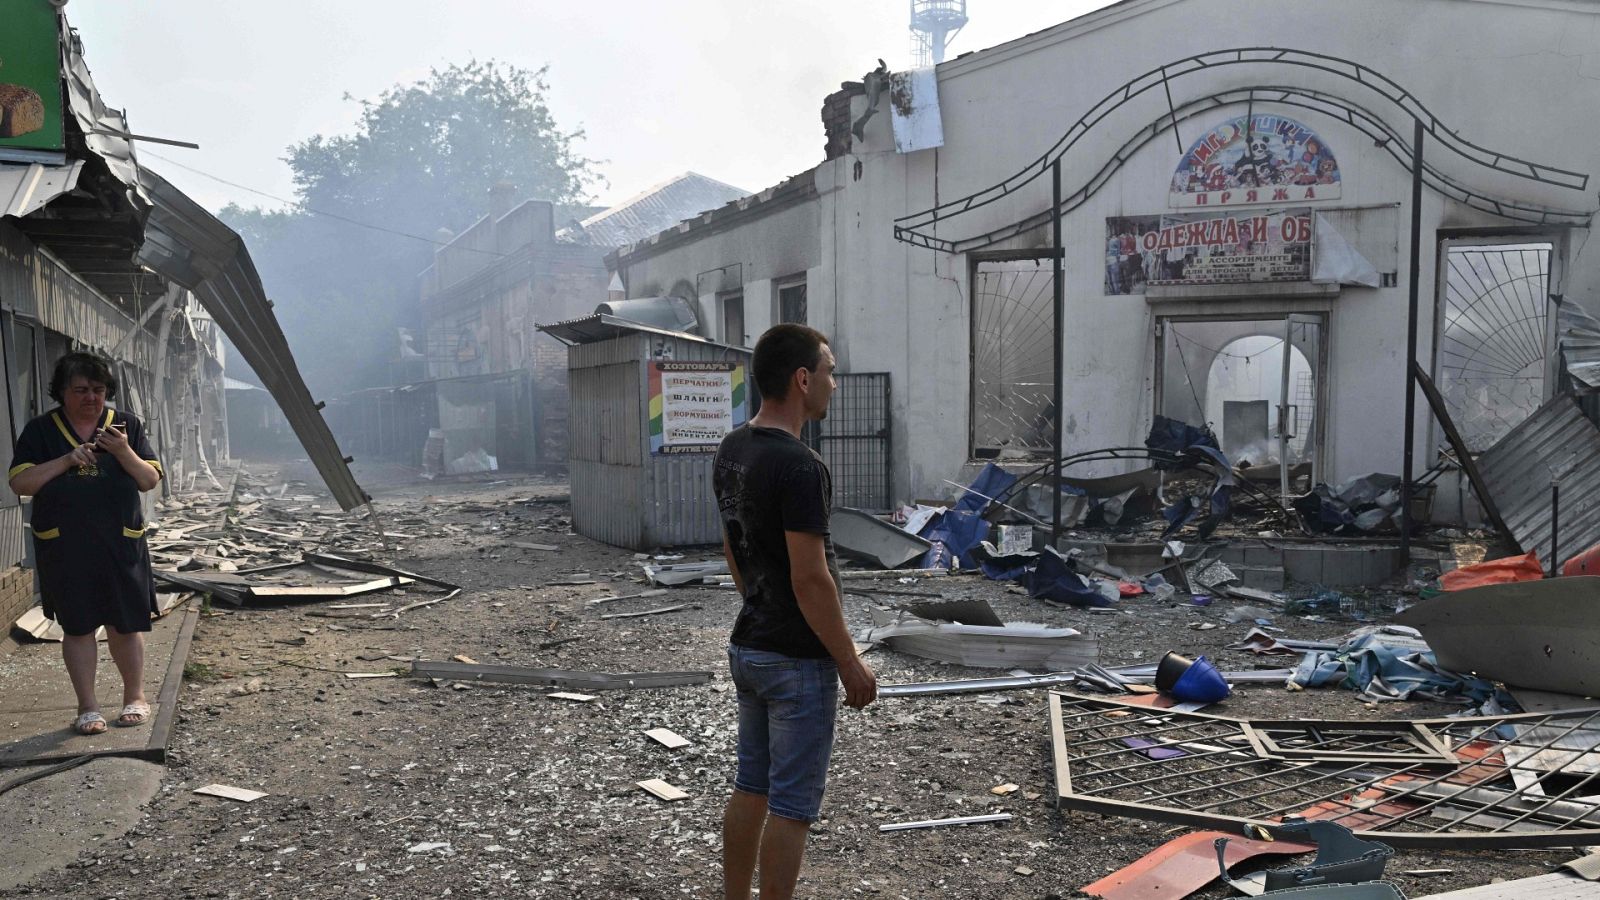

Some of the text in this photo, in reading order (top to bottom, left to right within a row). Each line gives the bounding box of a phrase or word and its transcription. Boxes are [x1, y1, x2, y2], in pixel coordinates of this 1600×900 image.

[1197, 188, 1315, 205] ПРЯЖА
[1143, 217, 1241, 251] ОДЕЖДА
[1252, 216, 1269, 243] И
[1209, 255, 1290, 263] АССОРТИМЕНТЕ
[673, 378, 719, 386] ПЕРЧАТКИ
[673, 394, 719, 402] ШЛАНГИ
